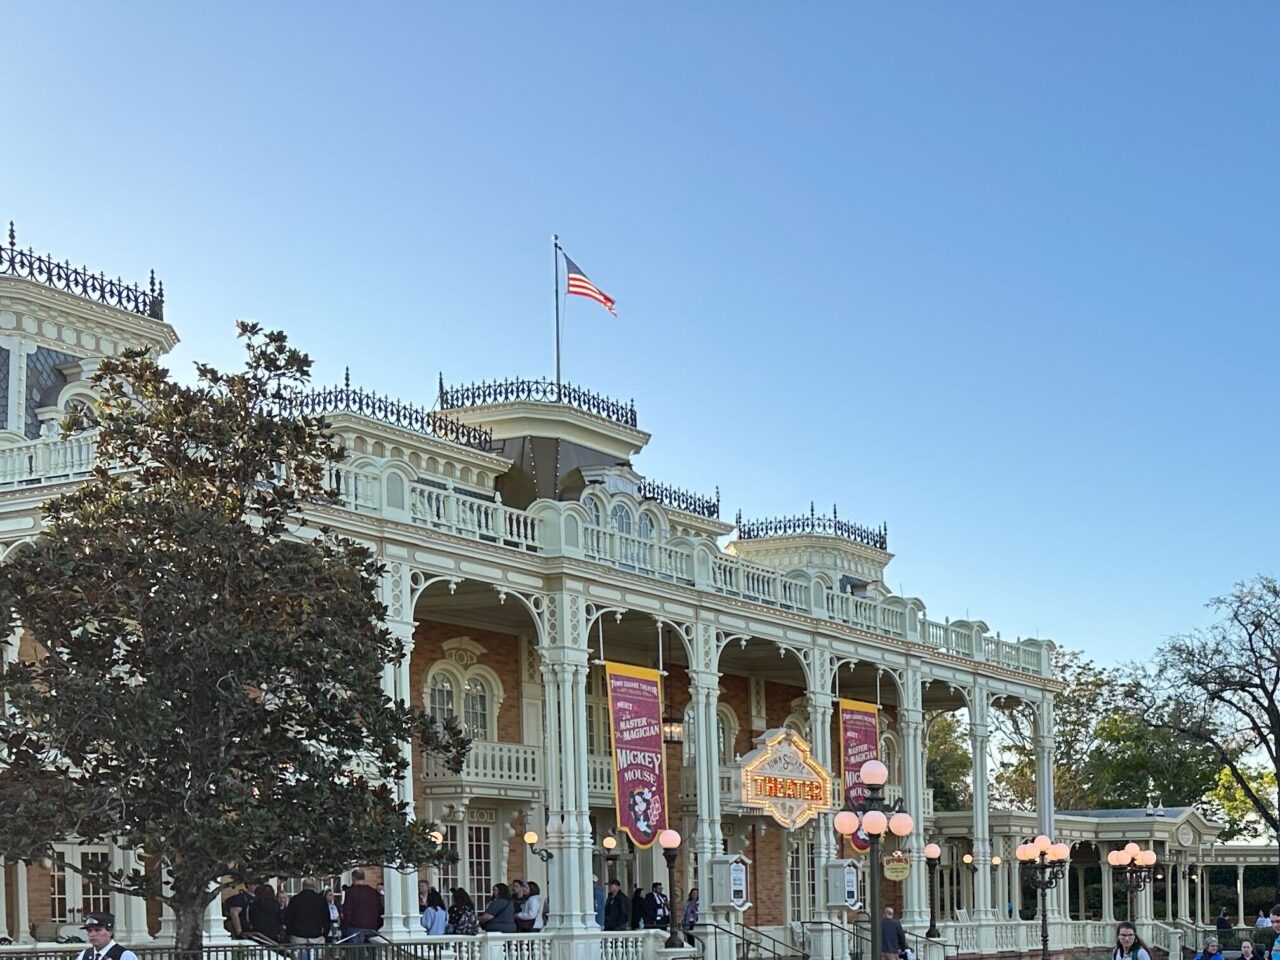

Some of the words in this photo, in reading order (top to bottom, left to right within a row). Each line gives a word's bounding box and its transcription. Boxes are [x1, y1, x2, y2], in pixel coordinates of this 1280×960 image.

[611, 680, 623, 688] TOWN
[623, 680, 639, 689] SQUARE
[640, 683, 657, 696] THEATER
[617, 701, 632, 710] MEET
[620, 717, 647, 730] MASTER
[623, 725, 660, 741] MAGICIAN
[848, 744, 868, 755] MASTER
[850, 750, 877, 764] MAGICIAN
[616, 749, 661, 774] MICKEY
[767, 756, 781, 769] TOWN
[624, 769, 657, 786] MOUSE
[845, 771, 862, 789] MIC
[753, 776, 822, 800] THEATER
[850, 787, 872, 798] MOUS
